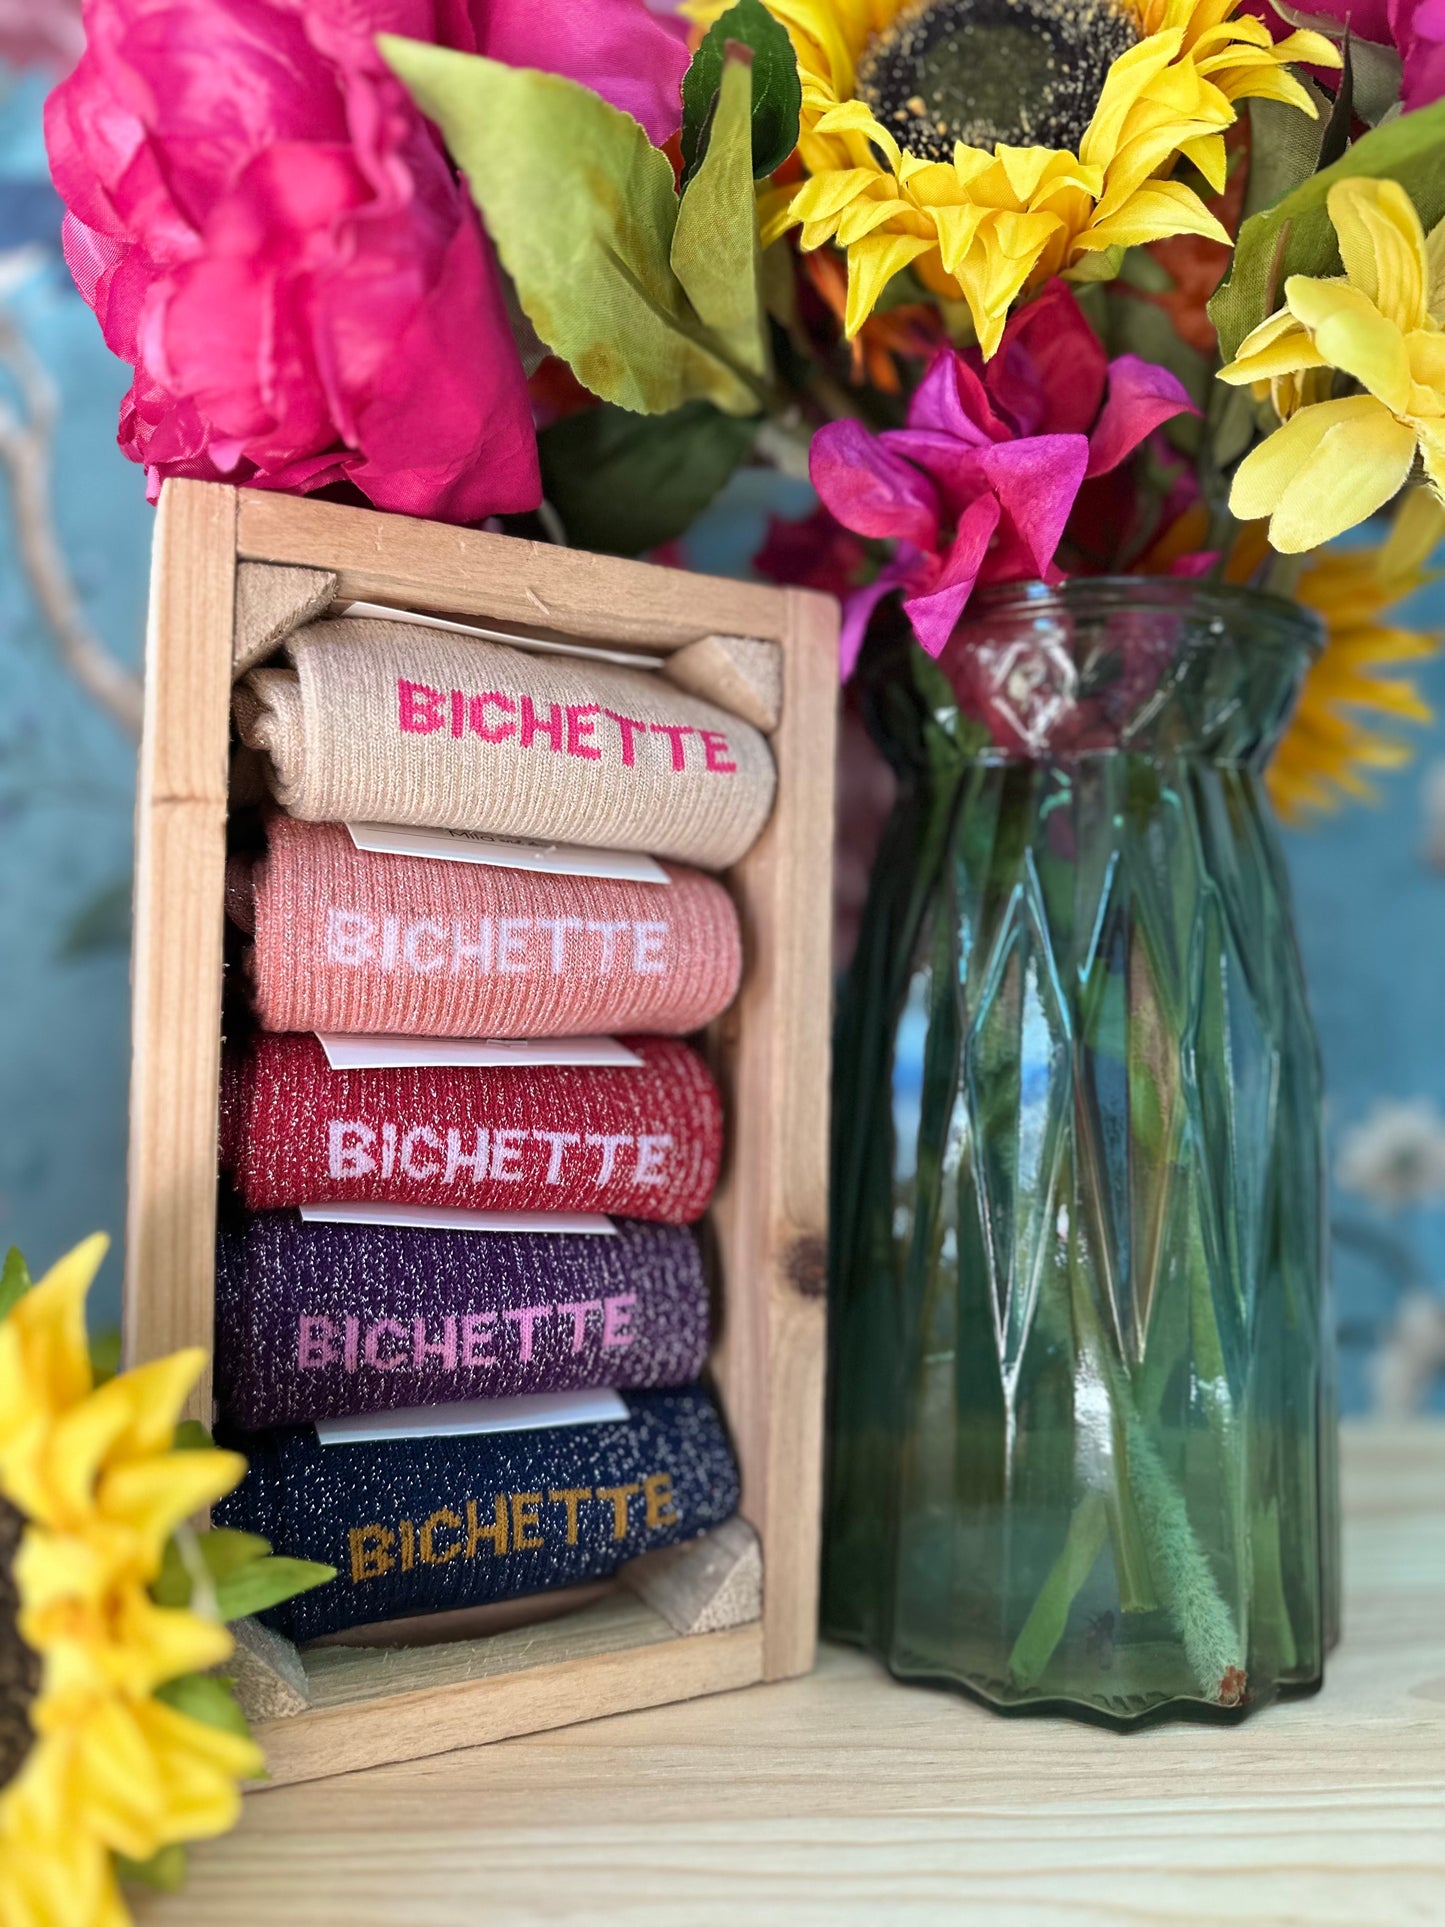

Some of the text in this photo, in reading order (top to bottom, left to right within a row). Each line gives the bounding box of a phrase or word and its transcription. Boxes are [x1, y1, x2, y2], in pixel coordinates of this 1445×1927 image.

[398, 678, 737, 773] BICHETTE
[327, 909, 670, 976] BICHETTE
[328, 1120, 673, 1185] BICHETTE
[298, 1294, 637, 1373] BICHETTE
[348, 1475, 679, 1582] BICHETTE
